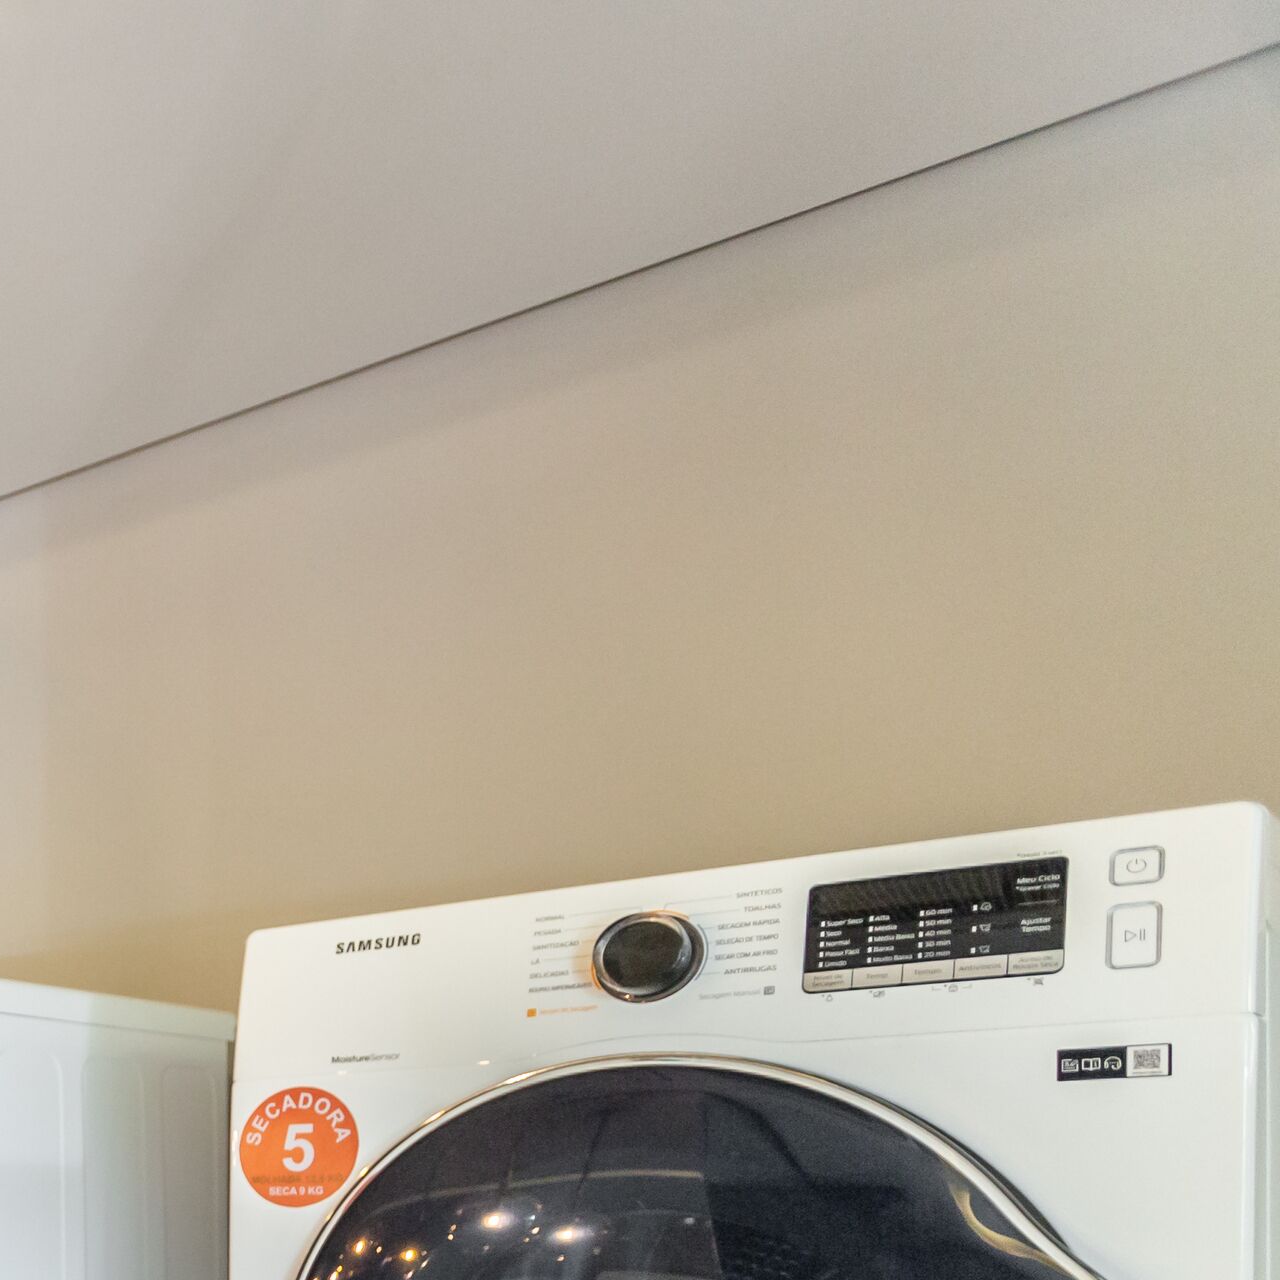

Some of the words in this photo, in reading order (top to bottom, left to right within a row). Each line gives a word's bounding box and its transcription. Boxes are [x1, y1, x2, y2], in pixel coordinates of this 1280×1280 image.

[336, 933, 421, 955] SAMSUNG
[246, 1092, 351, 1146] SECADORA
[282, 1123, 315, 1172] 5
[269, 1186, 297, 1196] SECA
[308, 1186, 324, 1195] KG
